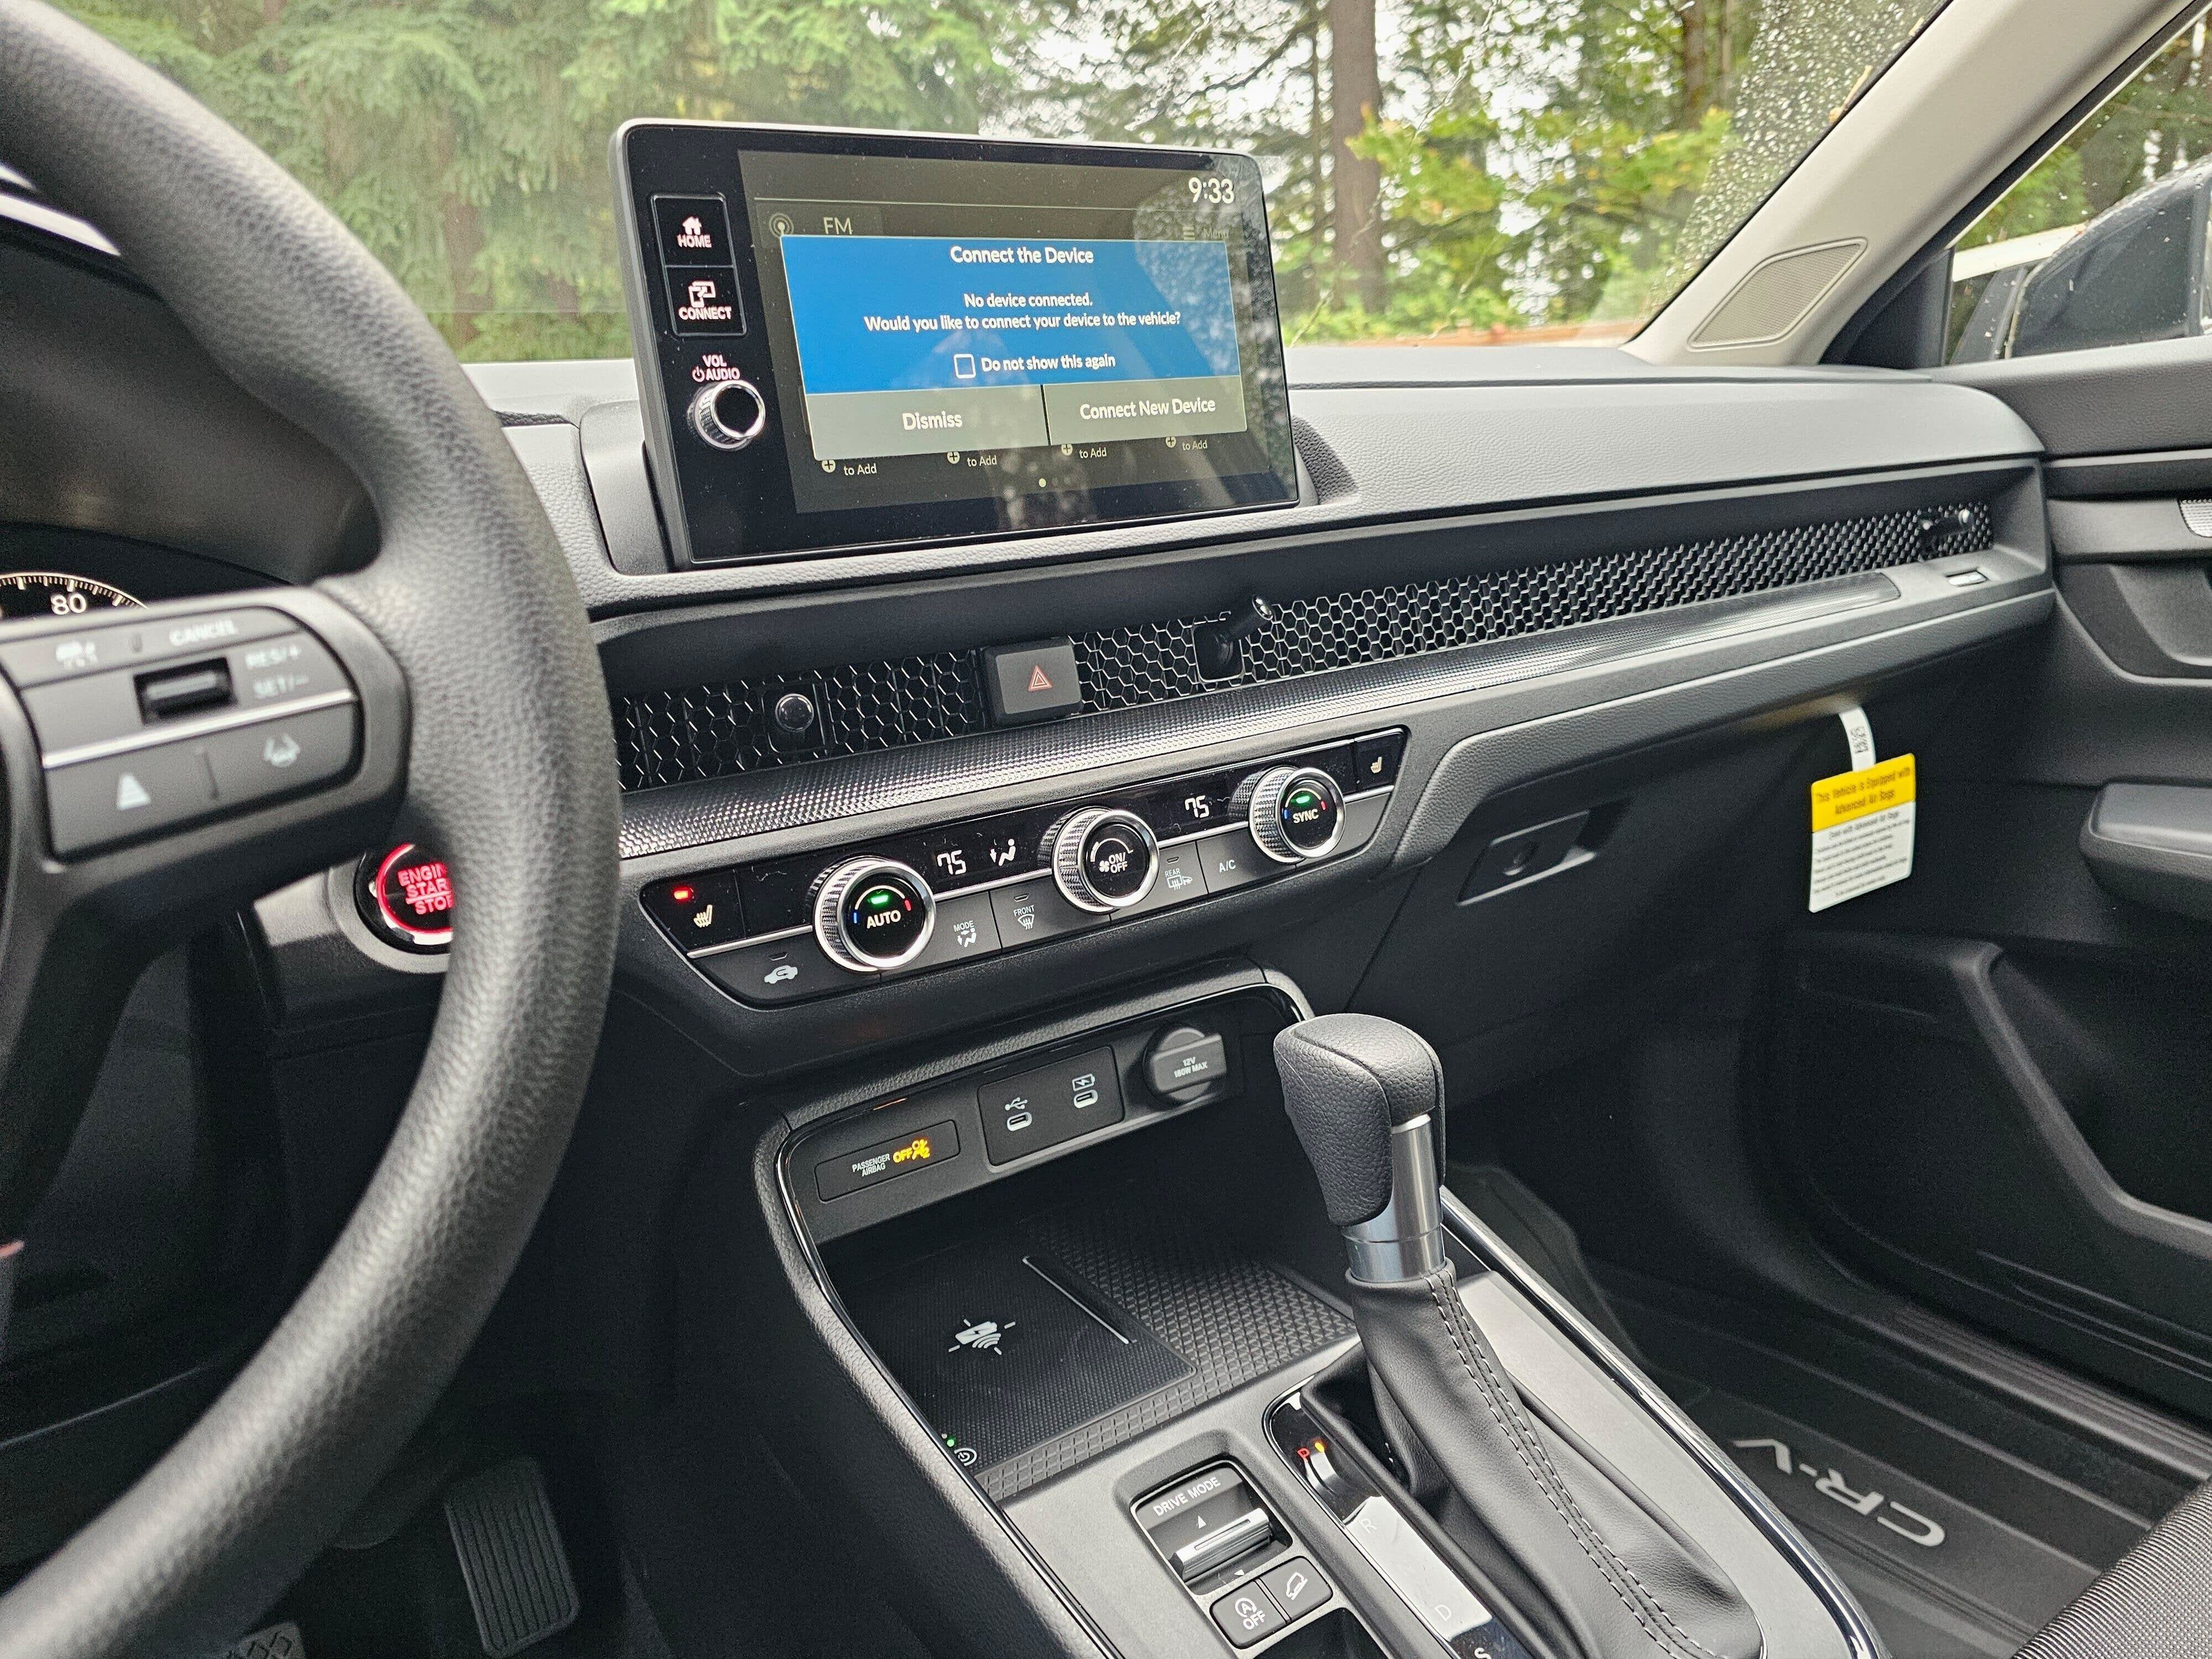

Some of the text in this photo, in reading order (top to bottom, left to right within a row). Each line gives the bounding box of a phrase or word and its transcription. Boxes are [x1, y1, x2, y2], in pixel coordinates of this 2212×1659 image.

[1189, 177, 1235, 204] 9:33
[823, 217, 852, 234] FM
[677, 234, 712, 248] HOME
[950, 246, 1094, 264] Connect the Device
[964, 293, 1093, 307] No device connected.
[679, 306, 732, 320] CONNECT
[864, 311, 1181, 332] Would you like to connect your device to the vehicle?
[702, 355, 727, 367] VOL
[981, 353, 1115, 372] Do not show this again
[706, 368, 740, 380] AUDIO
[1080, 398, 1215, 419] Connect New Device
[902, 411, 963, 430] Dismiss
[1079, 447, 1107, 458] to Add
[1182, 440, 1208, 451] to Add
[967, 455, 997, 467] to Add
[843, 463, 877, 476] to Add
[50, 592, 86, 615] 80
[170, 620, 237, 646] CANCEL
[1185, 795, 1210, 818] 75
[1293, 809, 1319, 823] SYNC
[937, 850, 967, 874] 75
[1108, 852, 1126, 864] ON/
[1110, 862, 1128, 874] OFF
[1165, 868, 1181, 877] REAR
[1219, 860, 1237, 873] A/C
[1013, 905, 1035, 917] FRONT
[867, 910, 901, 929] AUTO
[953, 920, 974, 932] MODE
[1183, 1056, 1196, 1067] 12V
[1192, 1061, 1208, 1072] MAX
[852, 1153, 890, 1172] PASSENGER
[893, 1147, 913, 1163] OFF
[862, 1163, 886, 1177] AIRBAG
[1153, 1477, 1221, 1516] DRIVE MODE
[1733, 1438, 1945, 1547] CR-V
[1358, 1517, 1378, 1534] R
[1243, 1609, 1265, 1630] OFF
[1434, 1604, 1452, 1621] D
